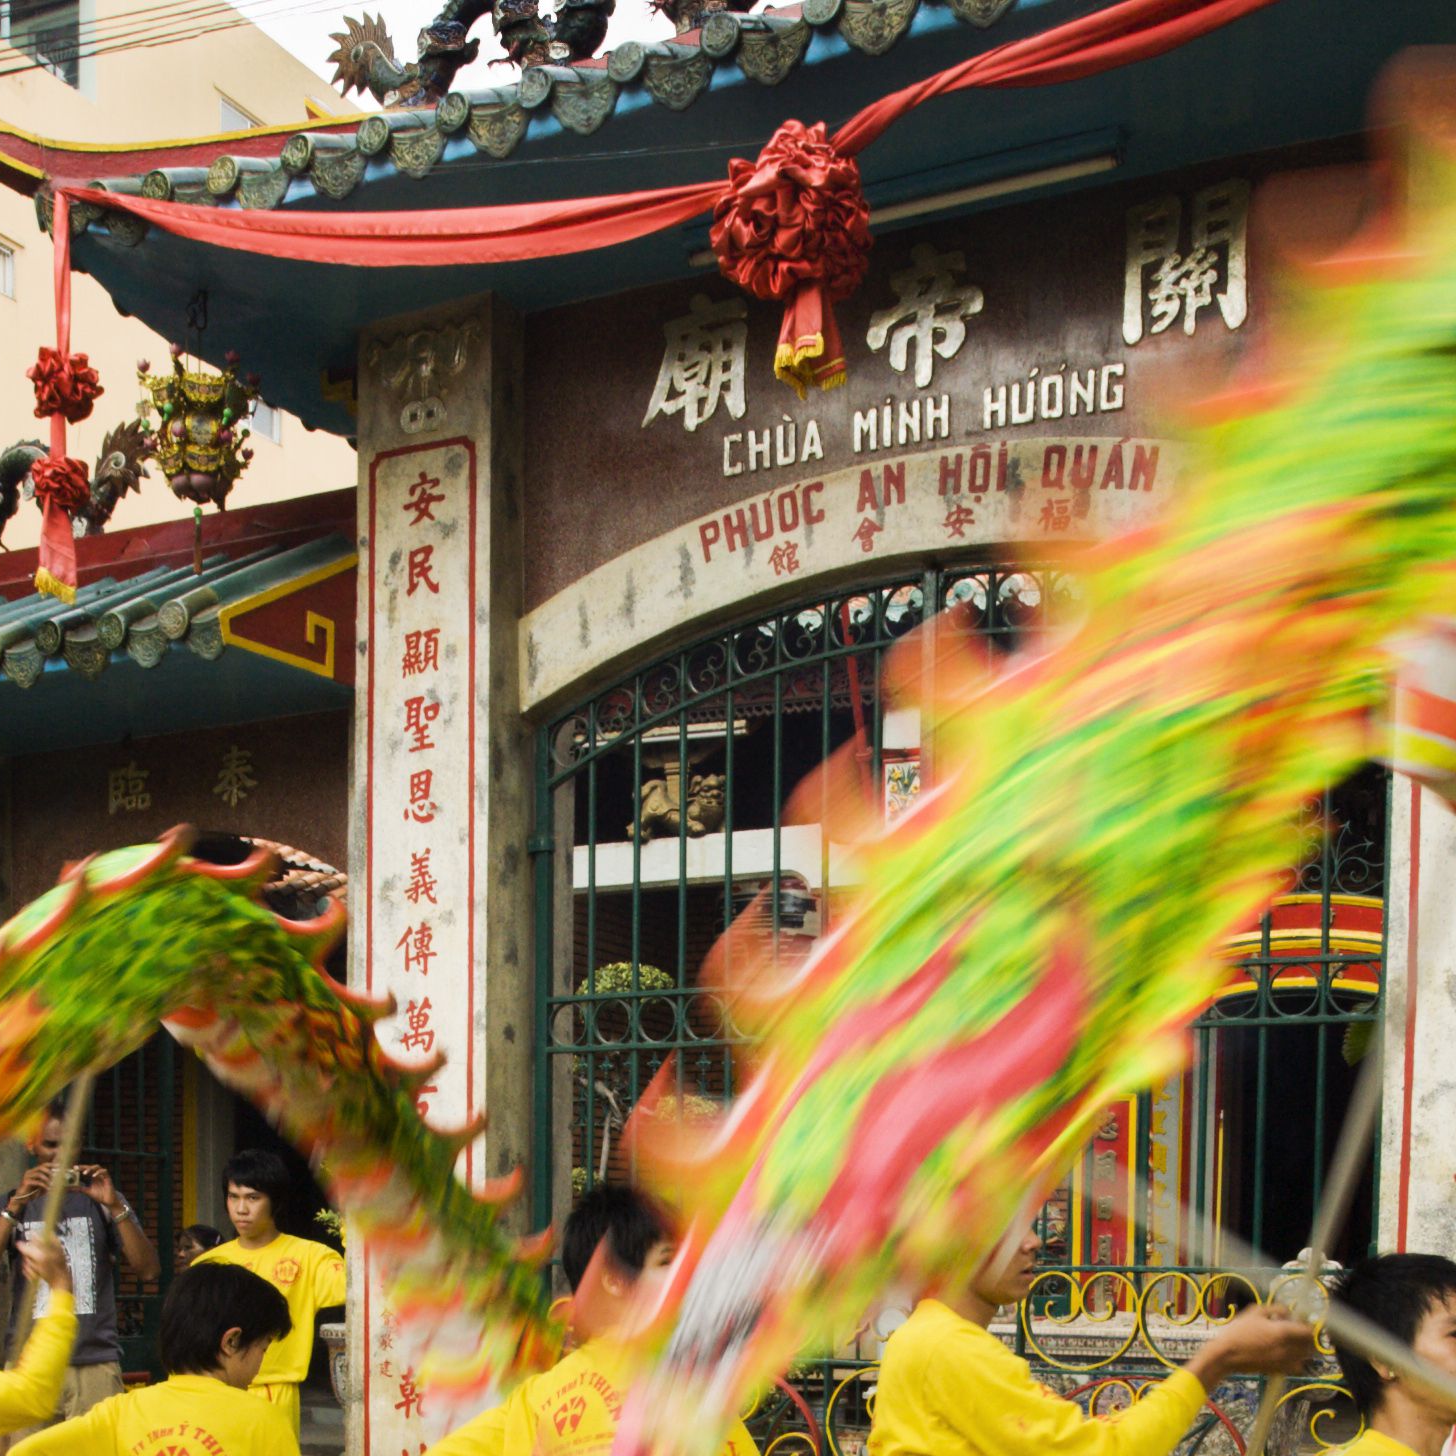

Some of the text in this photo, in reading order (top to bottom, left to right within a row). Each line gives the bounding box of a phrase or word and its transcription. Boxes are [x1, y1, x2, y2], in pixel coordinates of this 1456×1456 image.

[724, 414, 824, 476] CHÙA
[852, 393, 950, 453] MINH
[856, 461, 907, 513] AN
[937, 440, 1009, 504] HỘI
[1040, 436, 1161, 493] QUÁN
